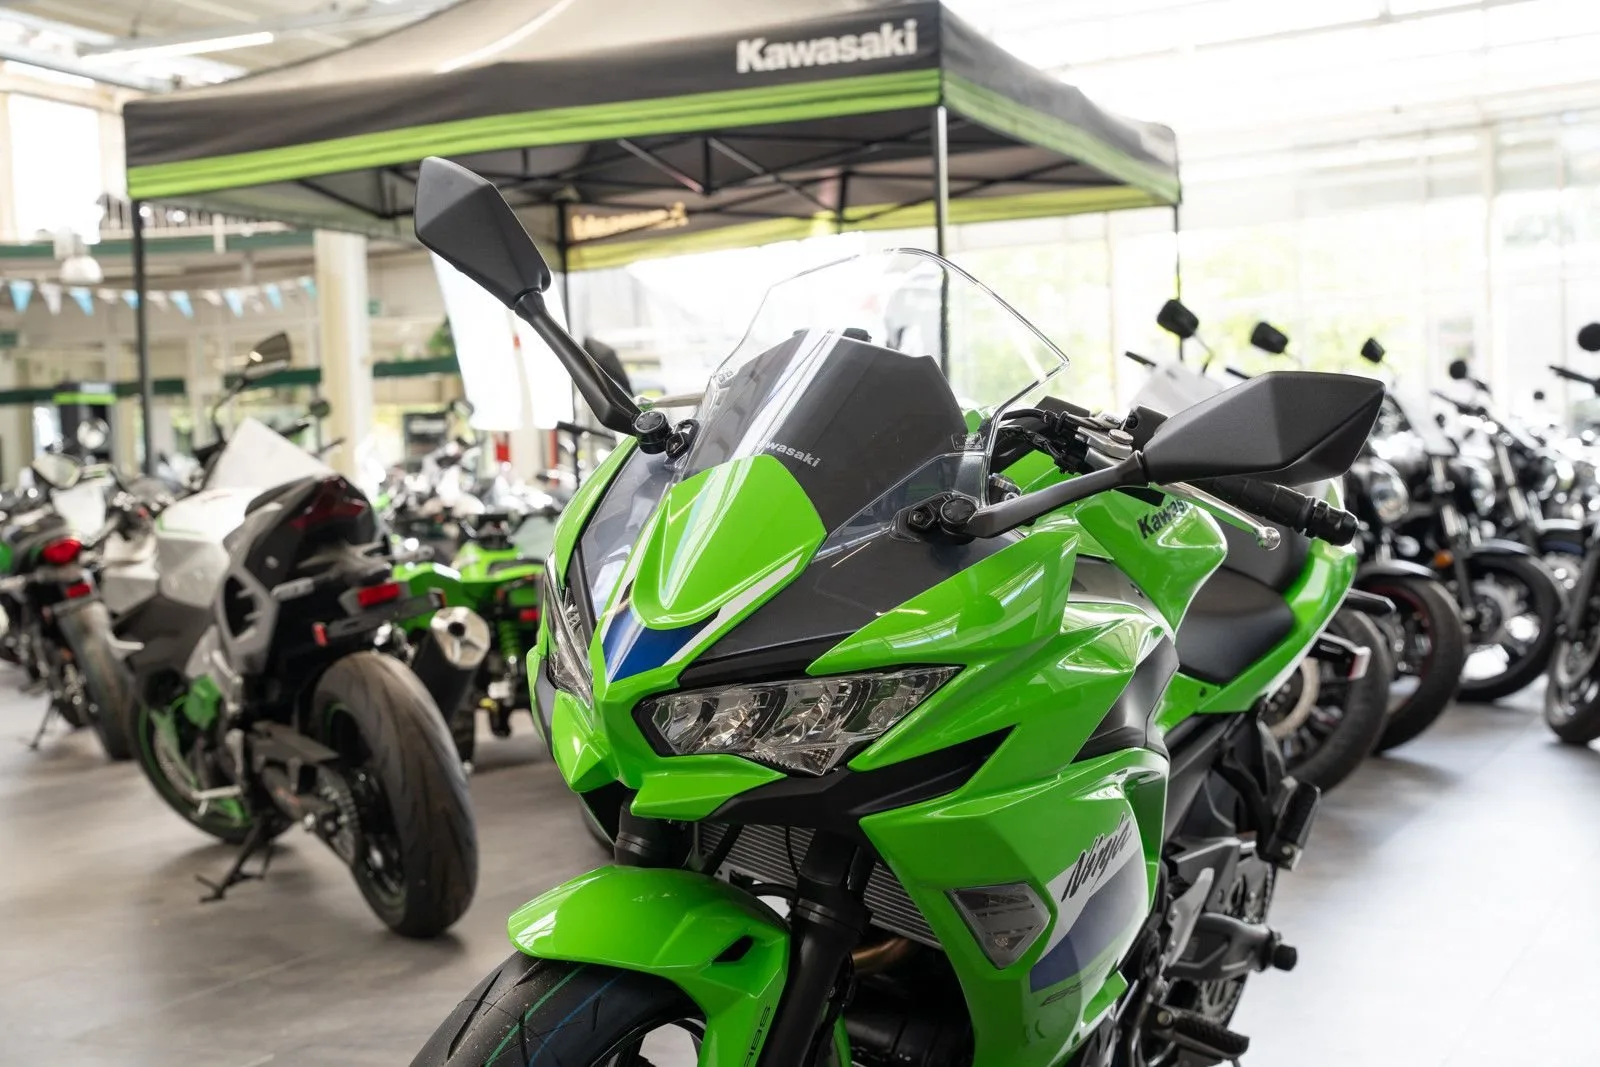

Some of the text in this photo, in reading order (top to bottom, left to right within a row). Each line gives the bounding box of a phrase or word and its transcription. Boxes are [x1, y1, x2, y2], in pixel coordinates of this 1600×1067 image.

[736, 18, 917, 73] Kawasaki
[765, 441, 821, 467] wasaki
[1137, 499, 1188, 539] Kawas
[1061, 813, 1132, 902] Ninja
